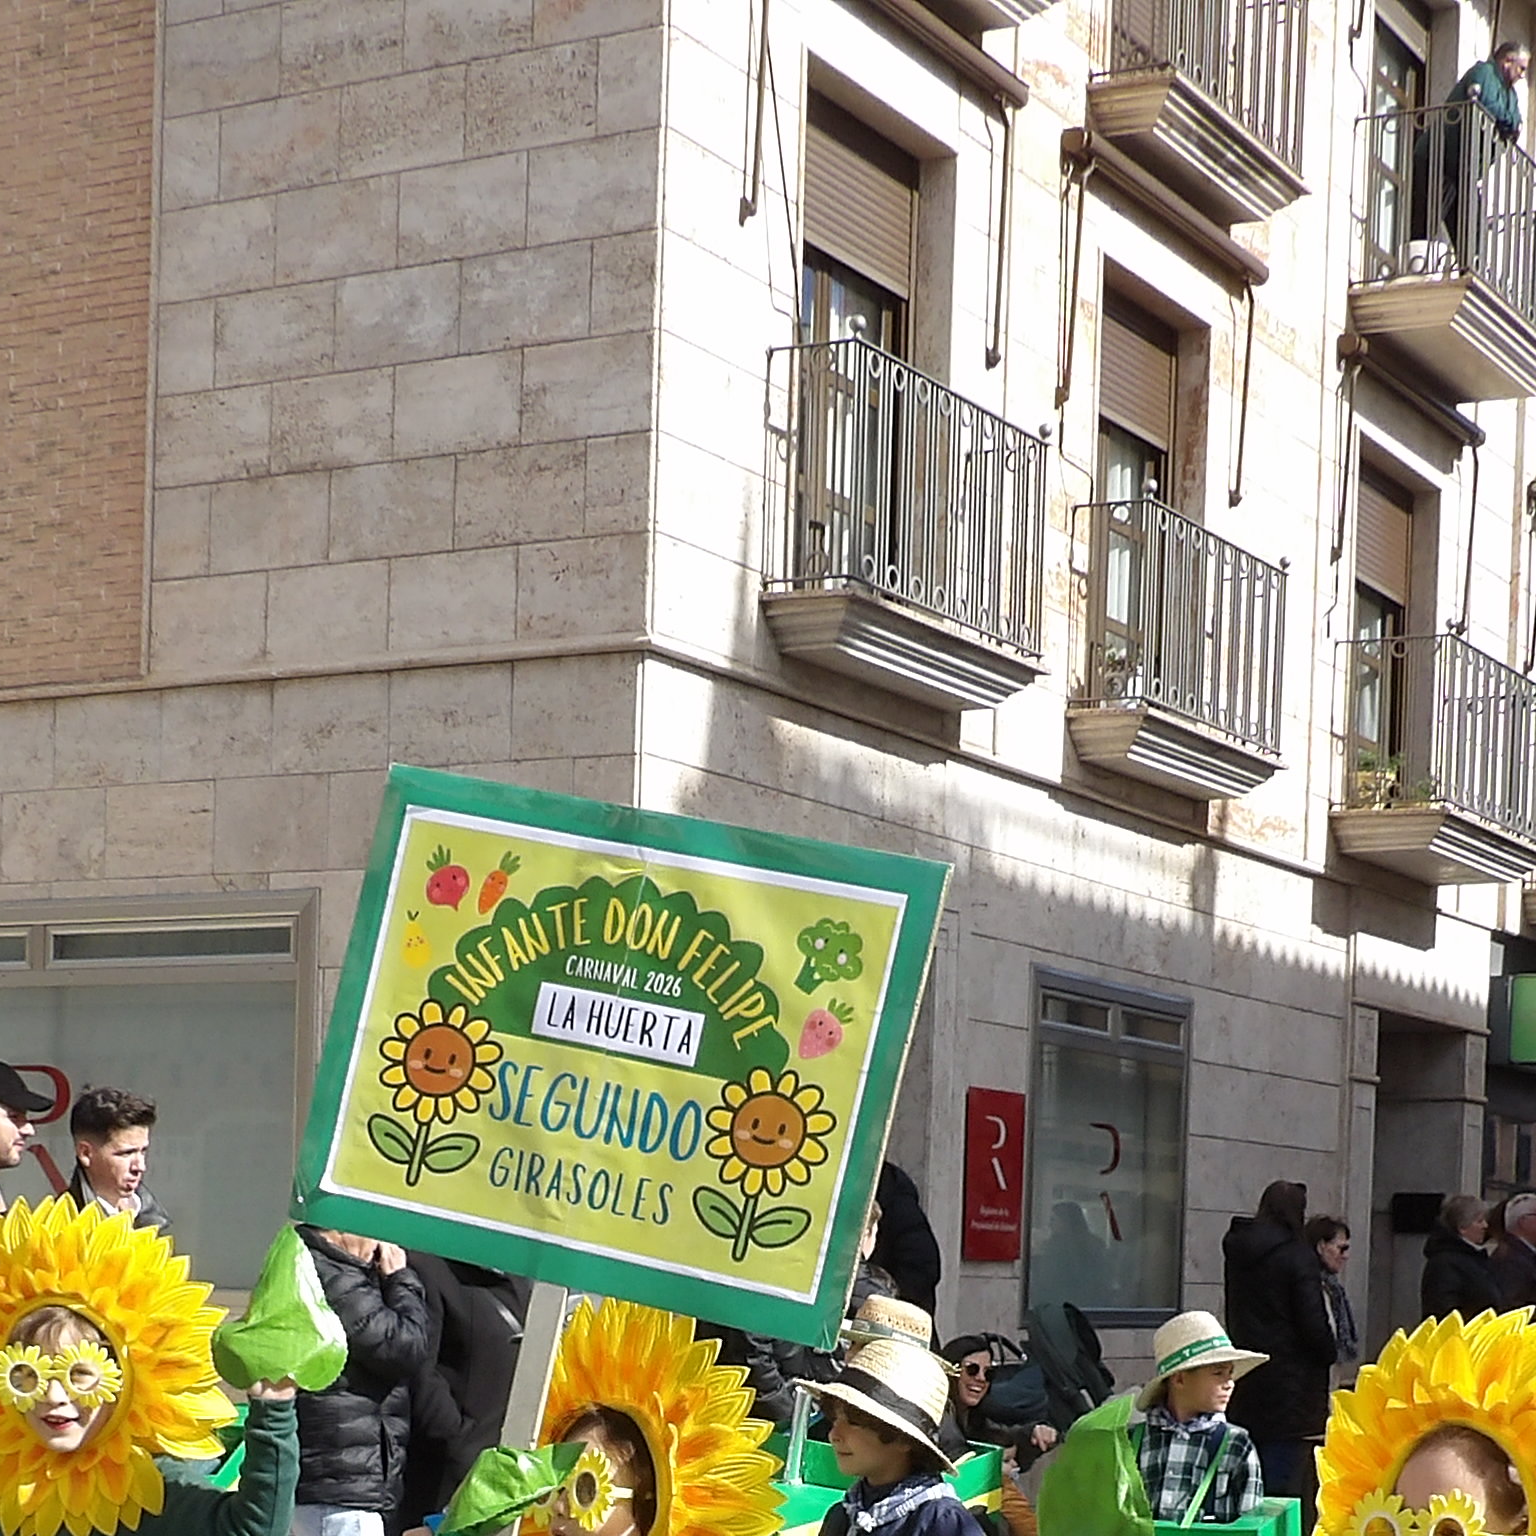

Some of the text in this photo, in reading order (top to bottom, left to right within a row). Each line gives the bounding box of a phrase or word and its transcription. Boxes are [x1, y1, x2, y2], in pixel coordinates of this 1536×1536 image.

[444, 896, 781, 1052] INFANTE DON FELIPE
[565, 953, 684, 999] CARNAVAL 2026
[545, 989, 694, 1057] LA HUERTA
[488, 1060, 704, 1164] SEGUNDO
[488, 1145, 675, 1227] GIRASOLES
